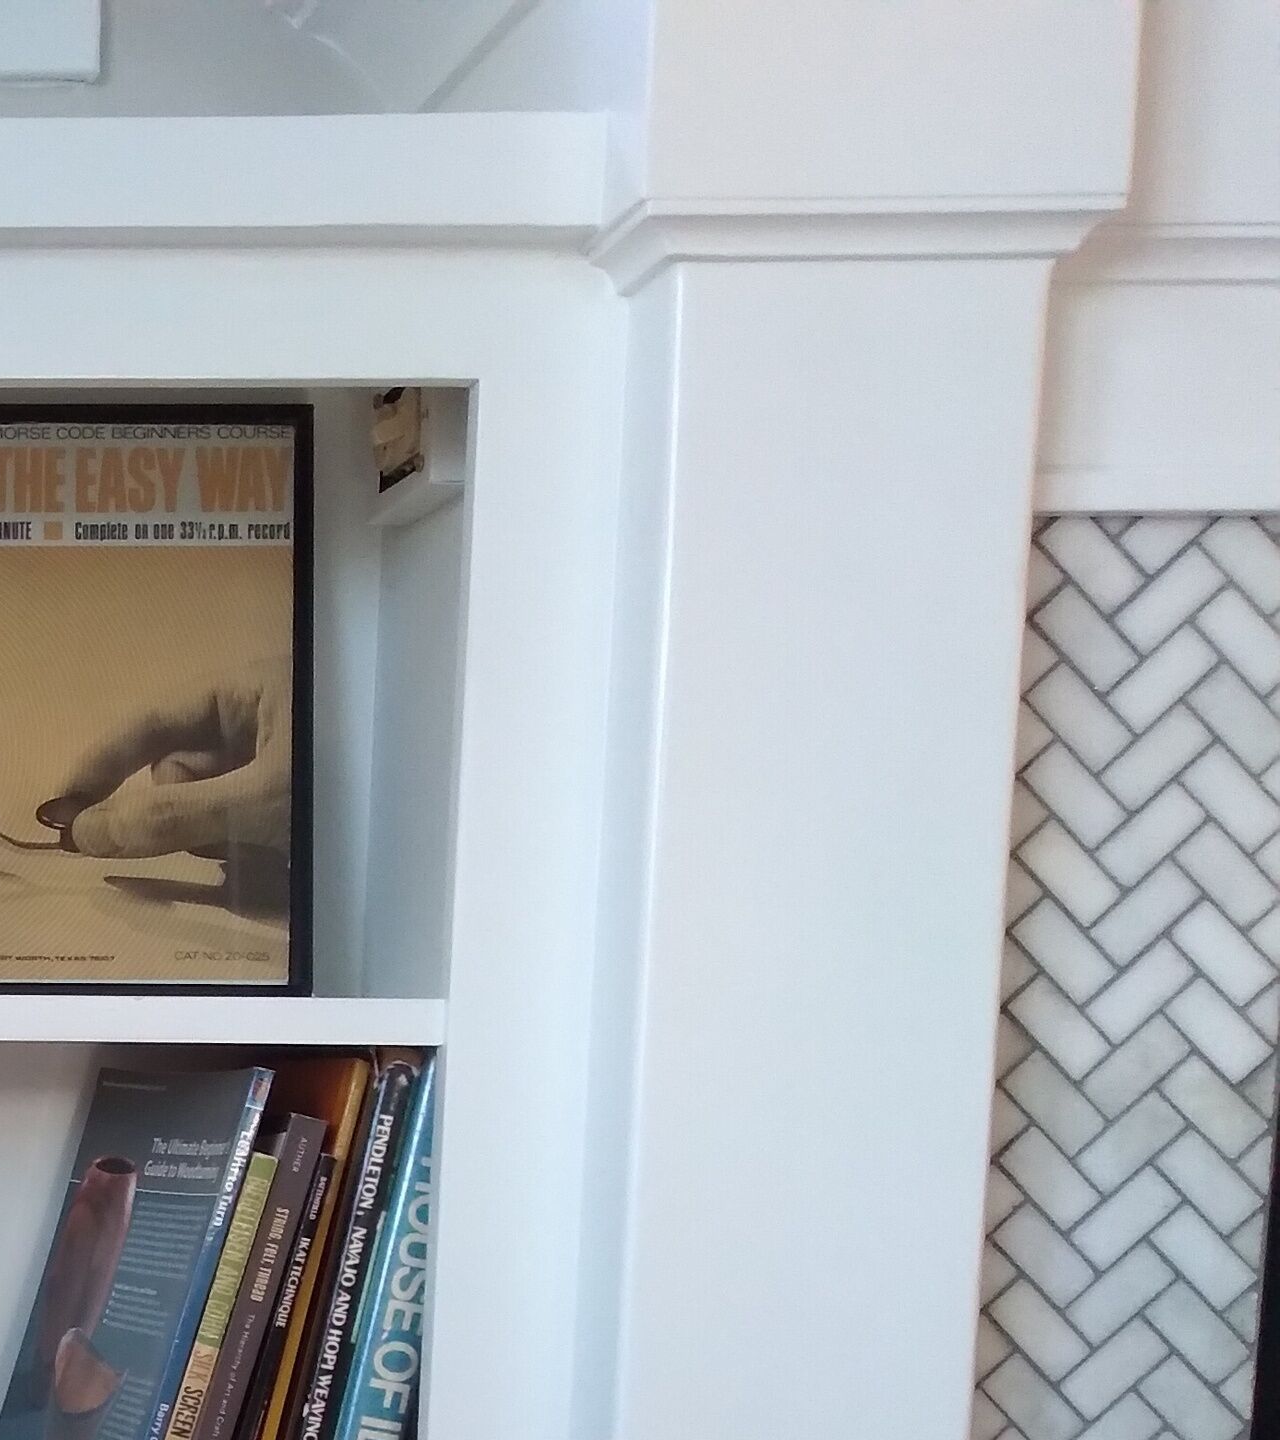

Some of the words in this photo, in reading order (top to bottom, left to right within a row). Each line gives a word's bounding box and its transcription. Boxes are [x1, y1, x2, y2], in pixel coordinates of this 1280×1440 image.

[56, 426, 106, 440] CODE
[111, 426, 211, 440] BEGINNERS
[216, 426, 291, 440] COURSE
[75, 446, 187, 513] EASY
[195, 446, 289, 513] WAY
[74, 520, 129, 542] Complete
[134, 523, 149, 541] on
[153, 522, 175, 541] one
[247, 522, 290, 541] record
[290, 1136, 308, 1172] AUTHER
[213, 1192, 236, 1227] Turn
[292, 1236, 311, 1265] IKAT
[337, 1225, 367, 1289] NAVAJO
[273, 1264, 303, 1328] TECHNIQUE
[328, 1289, 352, 1328] AND
[187, 1350, 212, 1381] SILK
[319, 1327, 343, 1373] HOPI
[369, 1341, 419, 1416] OF
[151, 1402, 170, 1434] Barry
[169, 1385, 204, 1438] SCREEN
